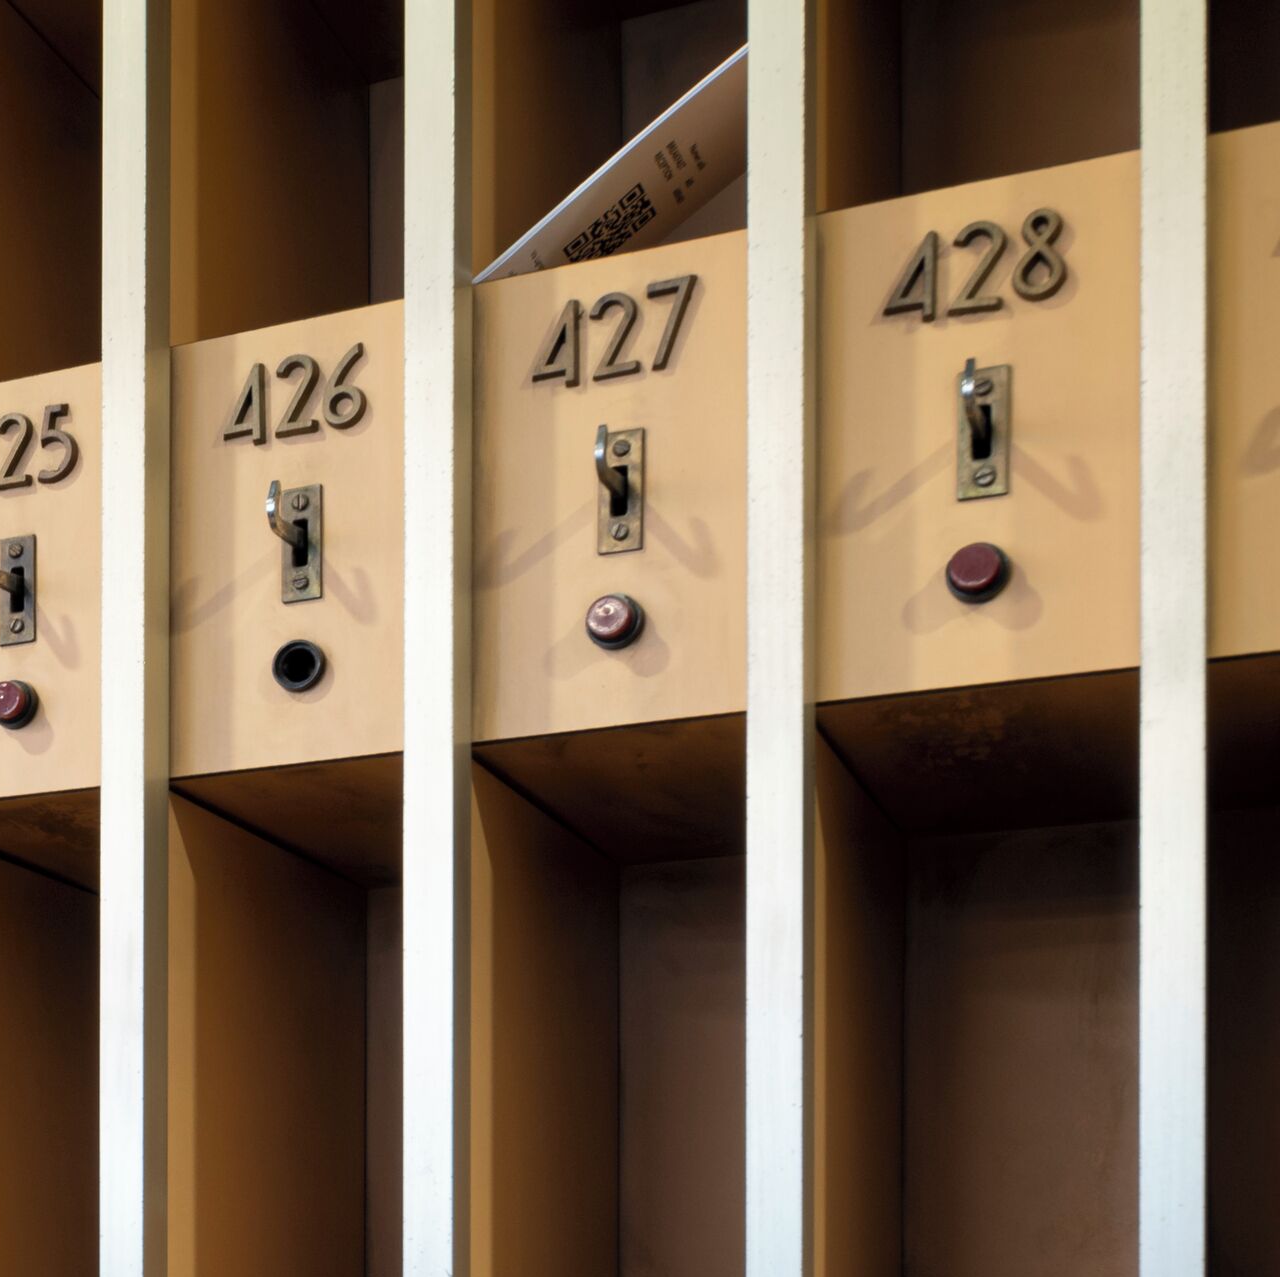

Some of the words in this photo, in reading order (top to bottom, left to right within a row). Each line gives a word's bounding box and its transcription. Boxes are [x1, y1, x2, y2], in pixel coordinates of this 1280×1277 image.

[883, 207, 1068, 323] 428
[532, 274, 699, 388] 427
[224, 342, 368, 445] 426
